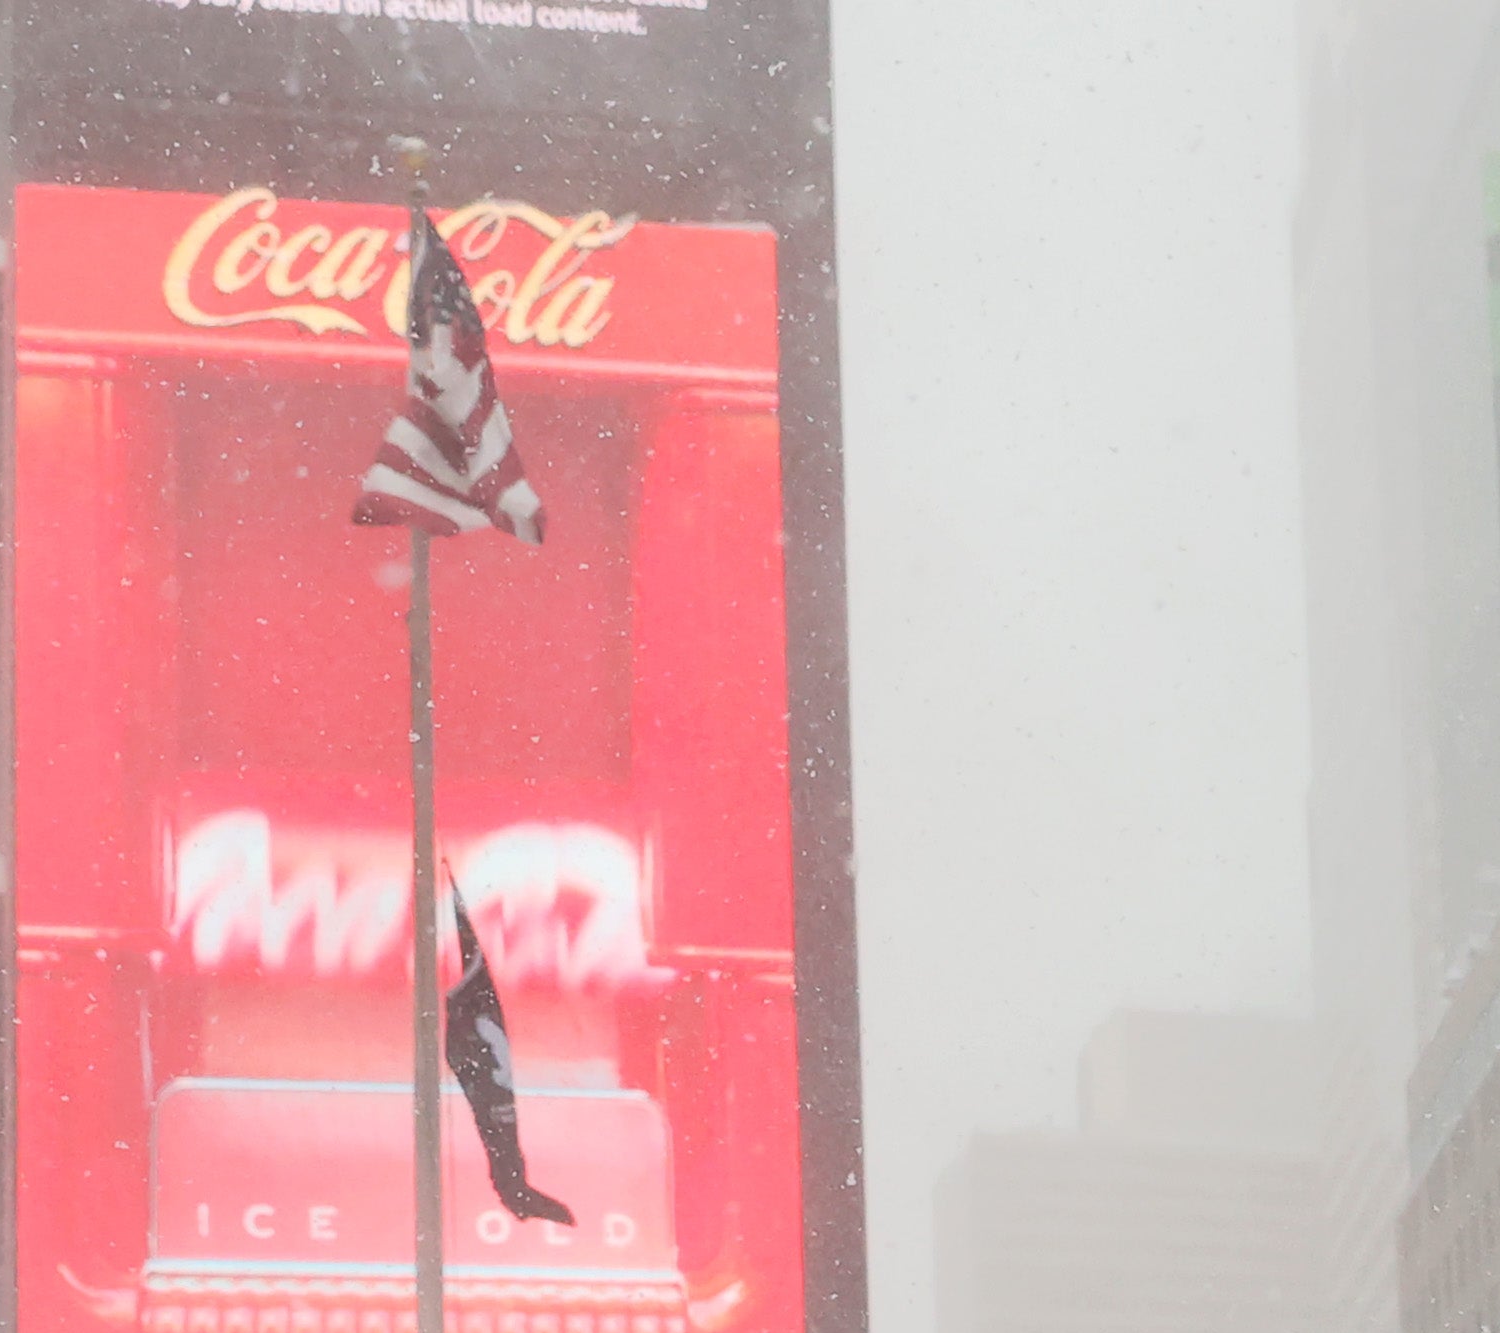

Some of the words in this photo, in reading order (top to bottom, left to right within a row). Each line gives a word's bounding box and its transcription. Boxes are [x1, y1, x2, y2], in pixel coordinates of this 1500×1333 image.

[473, 0, 533, 28] load
[536, 5, 647, 36] content.
[195, 1203, 339, 1242] ICE
[474, 1211, 638, 1249] OLD
